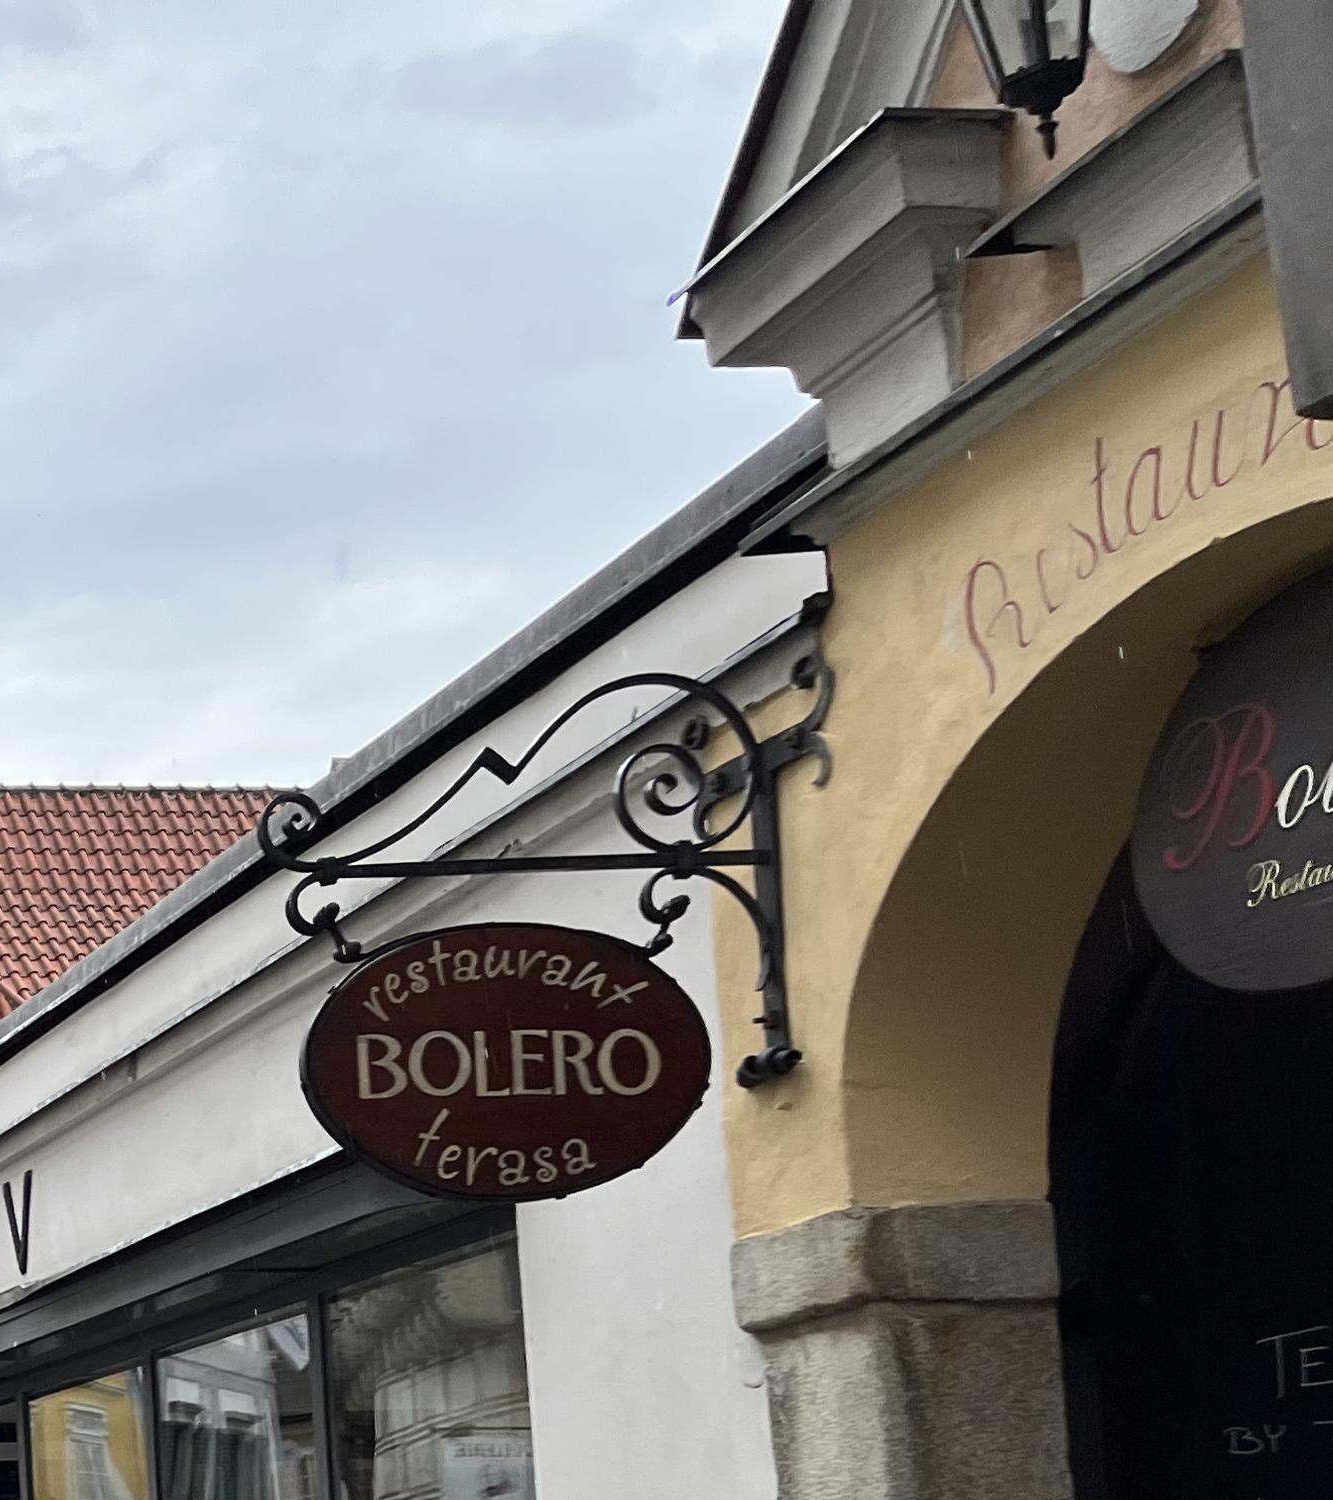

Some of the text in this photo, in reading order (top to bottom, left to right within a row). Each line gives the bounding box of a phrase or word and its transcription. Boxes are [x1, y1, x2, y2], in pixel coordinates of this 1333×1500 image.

[965, 375, 1333, 694] Restaur
[362, 940, 650, 1022] restaurant
[356, 1028, 662, 1099] BOLERO
[413, 1108, 598, 1186] terasa
[1223, 1424, 1287, 1454] BY
